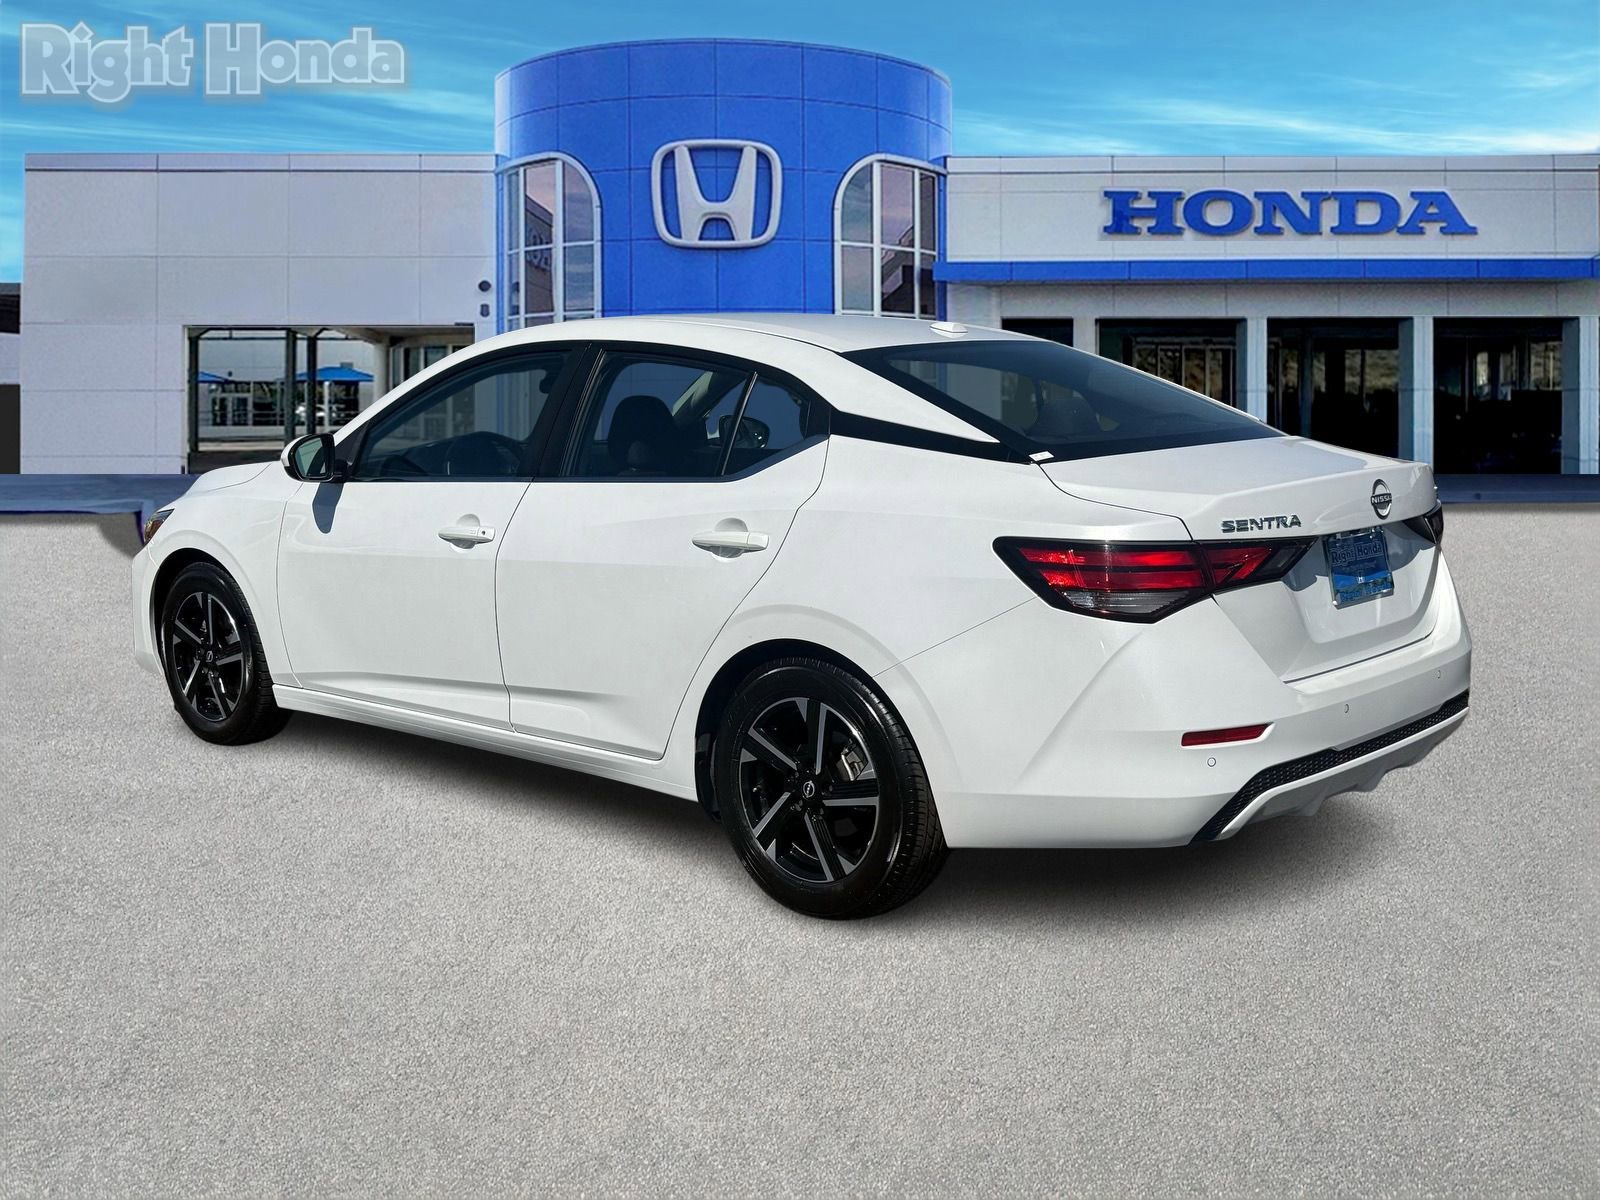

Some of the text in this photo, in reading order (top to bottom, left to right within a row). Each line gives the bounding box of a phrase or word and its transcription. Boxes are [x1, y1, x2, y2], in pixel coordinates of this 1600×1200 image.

[1103, 189, 1478, 236] HONDA
[1221, 514, 1301, 533] SENTRA
[1356, 541, 1384, 559] Honda
